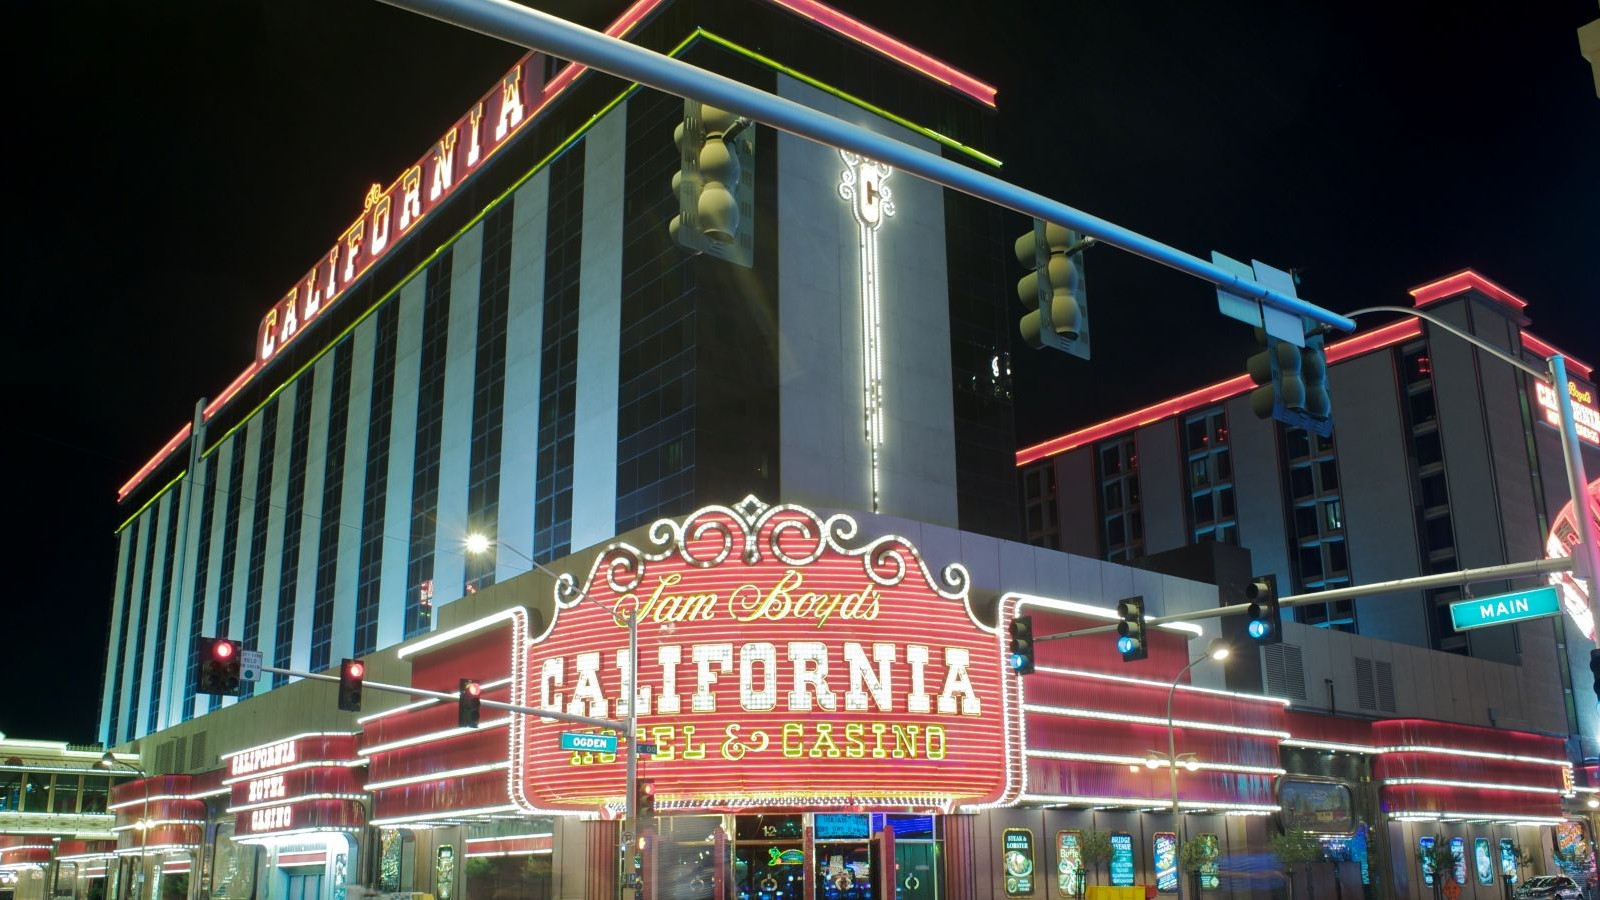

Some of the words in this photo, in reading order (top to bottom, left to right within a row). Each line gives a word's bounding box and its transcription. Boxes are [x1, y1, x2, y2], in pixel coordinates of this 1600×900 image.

[262, 65, 524, 360] CALIFORNIA
[613, 573, 718, 627] Sam
[729, 569, 881, 628] Boyd's
[1480, 598, 1529, 618] MAIN
[540, 642, 981, 723] CALIFORNIA
[573, 736, 607, 748] OGDEN
[721, 723, 770, 761] &
[783, 722, 947, 761] CASINO
[232, 741, 296, 775] CALIFORNIA
[248, 775, 285, 802] HOTEL
[251, 806, 292, 831] CASINO
[762, 825, 777, 837] 12
[1111, 836, 1131, 844] BRIDGE
